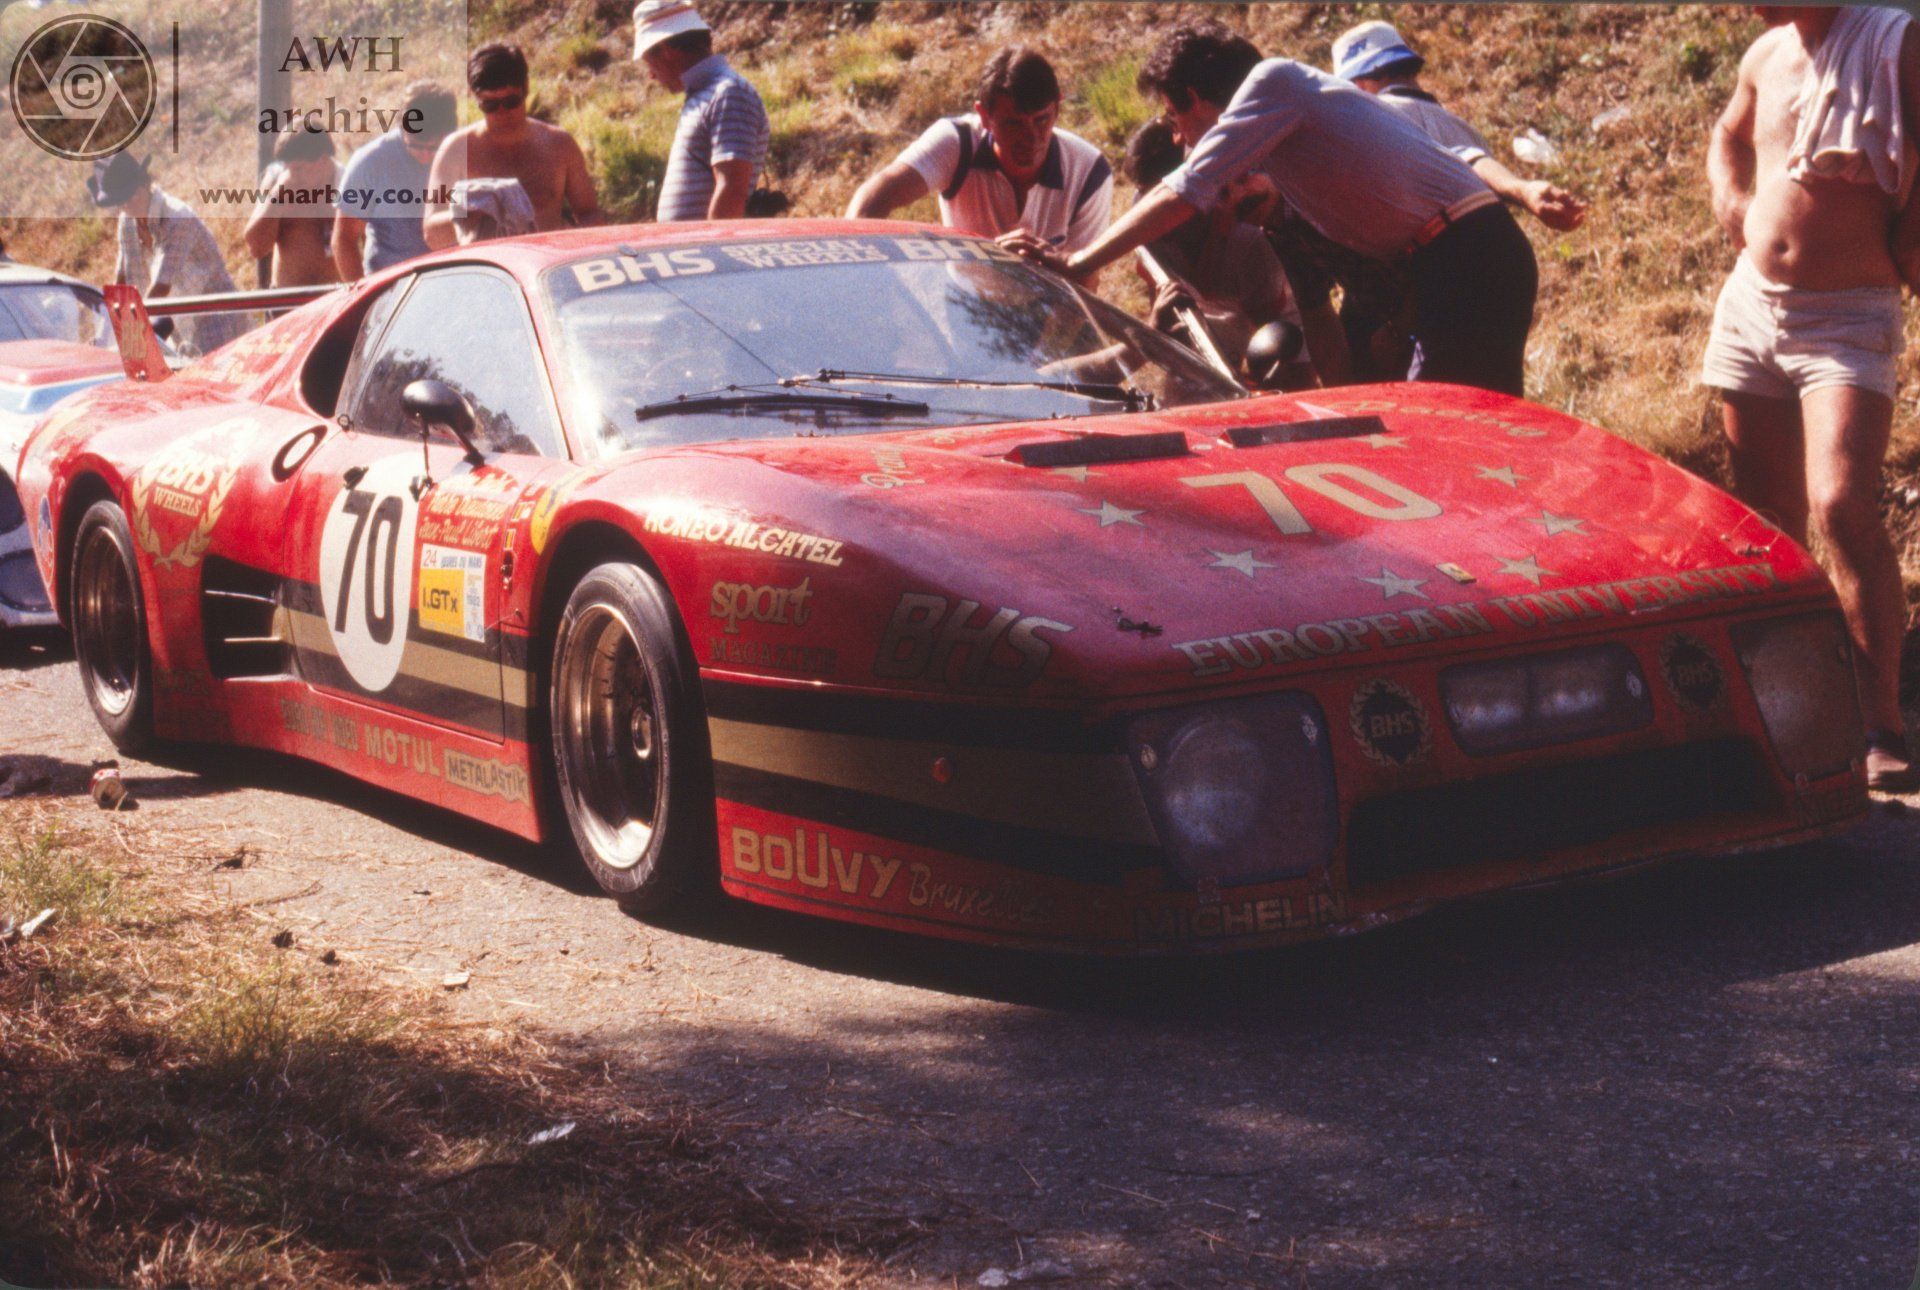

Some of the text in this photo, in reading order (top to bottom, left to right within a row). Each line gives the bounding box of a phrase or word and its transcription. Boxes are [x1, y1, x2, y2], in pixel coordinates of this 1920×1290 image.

[572, 248, 716, 294] BHS
[720, 239, 877, 258] SPECIAL
[735, 249, 890, 268] WHEELS
[894, 238, 1025, 263] BHS
[153, 486, 203, 518] WHEELS
[1177, 461, 1445, 535] 70
[334, 489, 404, 645] 70
[423, 549, 438, 568] 24
[724, 519, 844, 567] ALCATEL
[709, 575, 815, 634] sport
[1172, 561, 1789, 677] EUROPEAN UNIVERSITY
[873, 591, 1076, 690] BHS
[1370, 703, 1416, 739] BHS
[364, 722, 441, 777] MOTUL
[731, 825, 903, 900] BOUVY
[1134, 891, 1347, 940] MICHELIN
